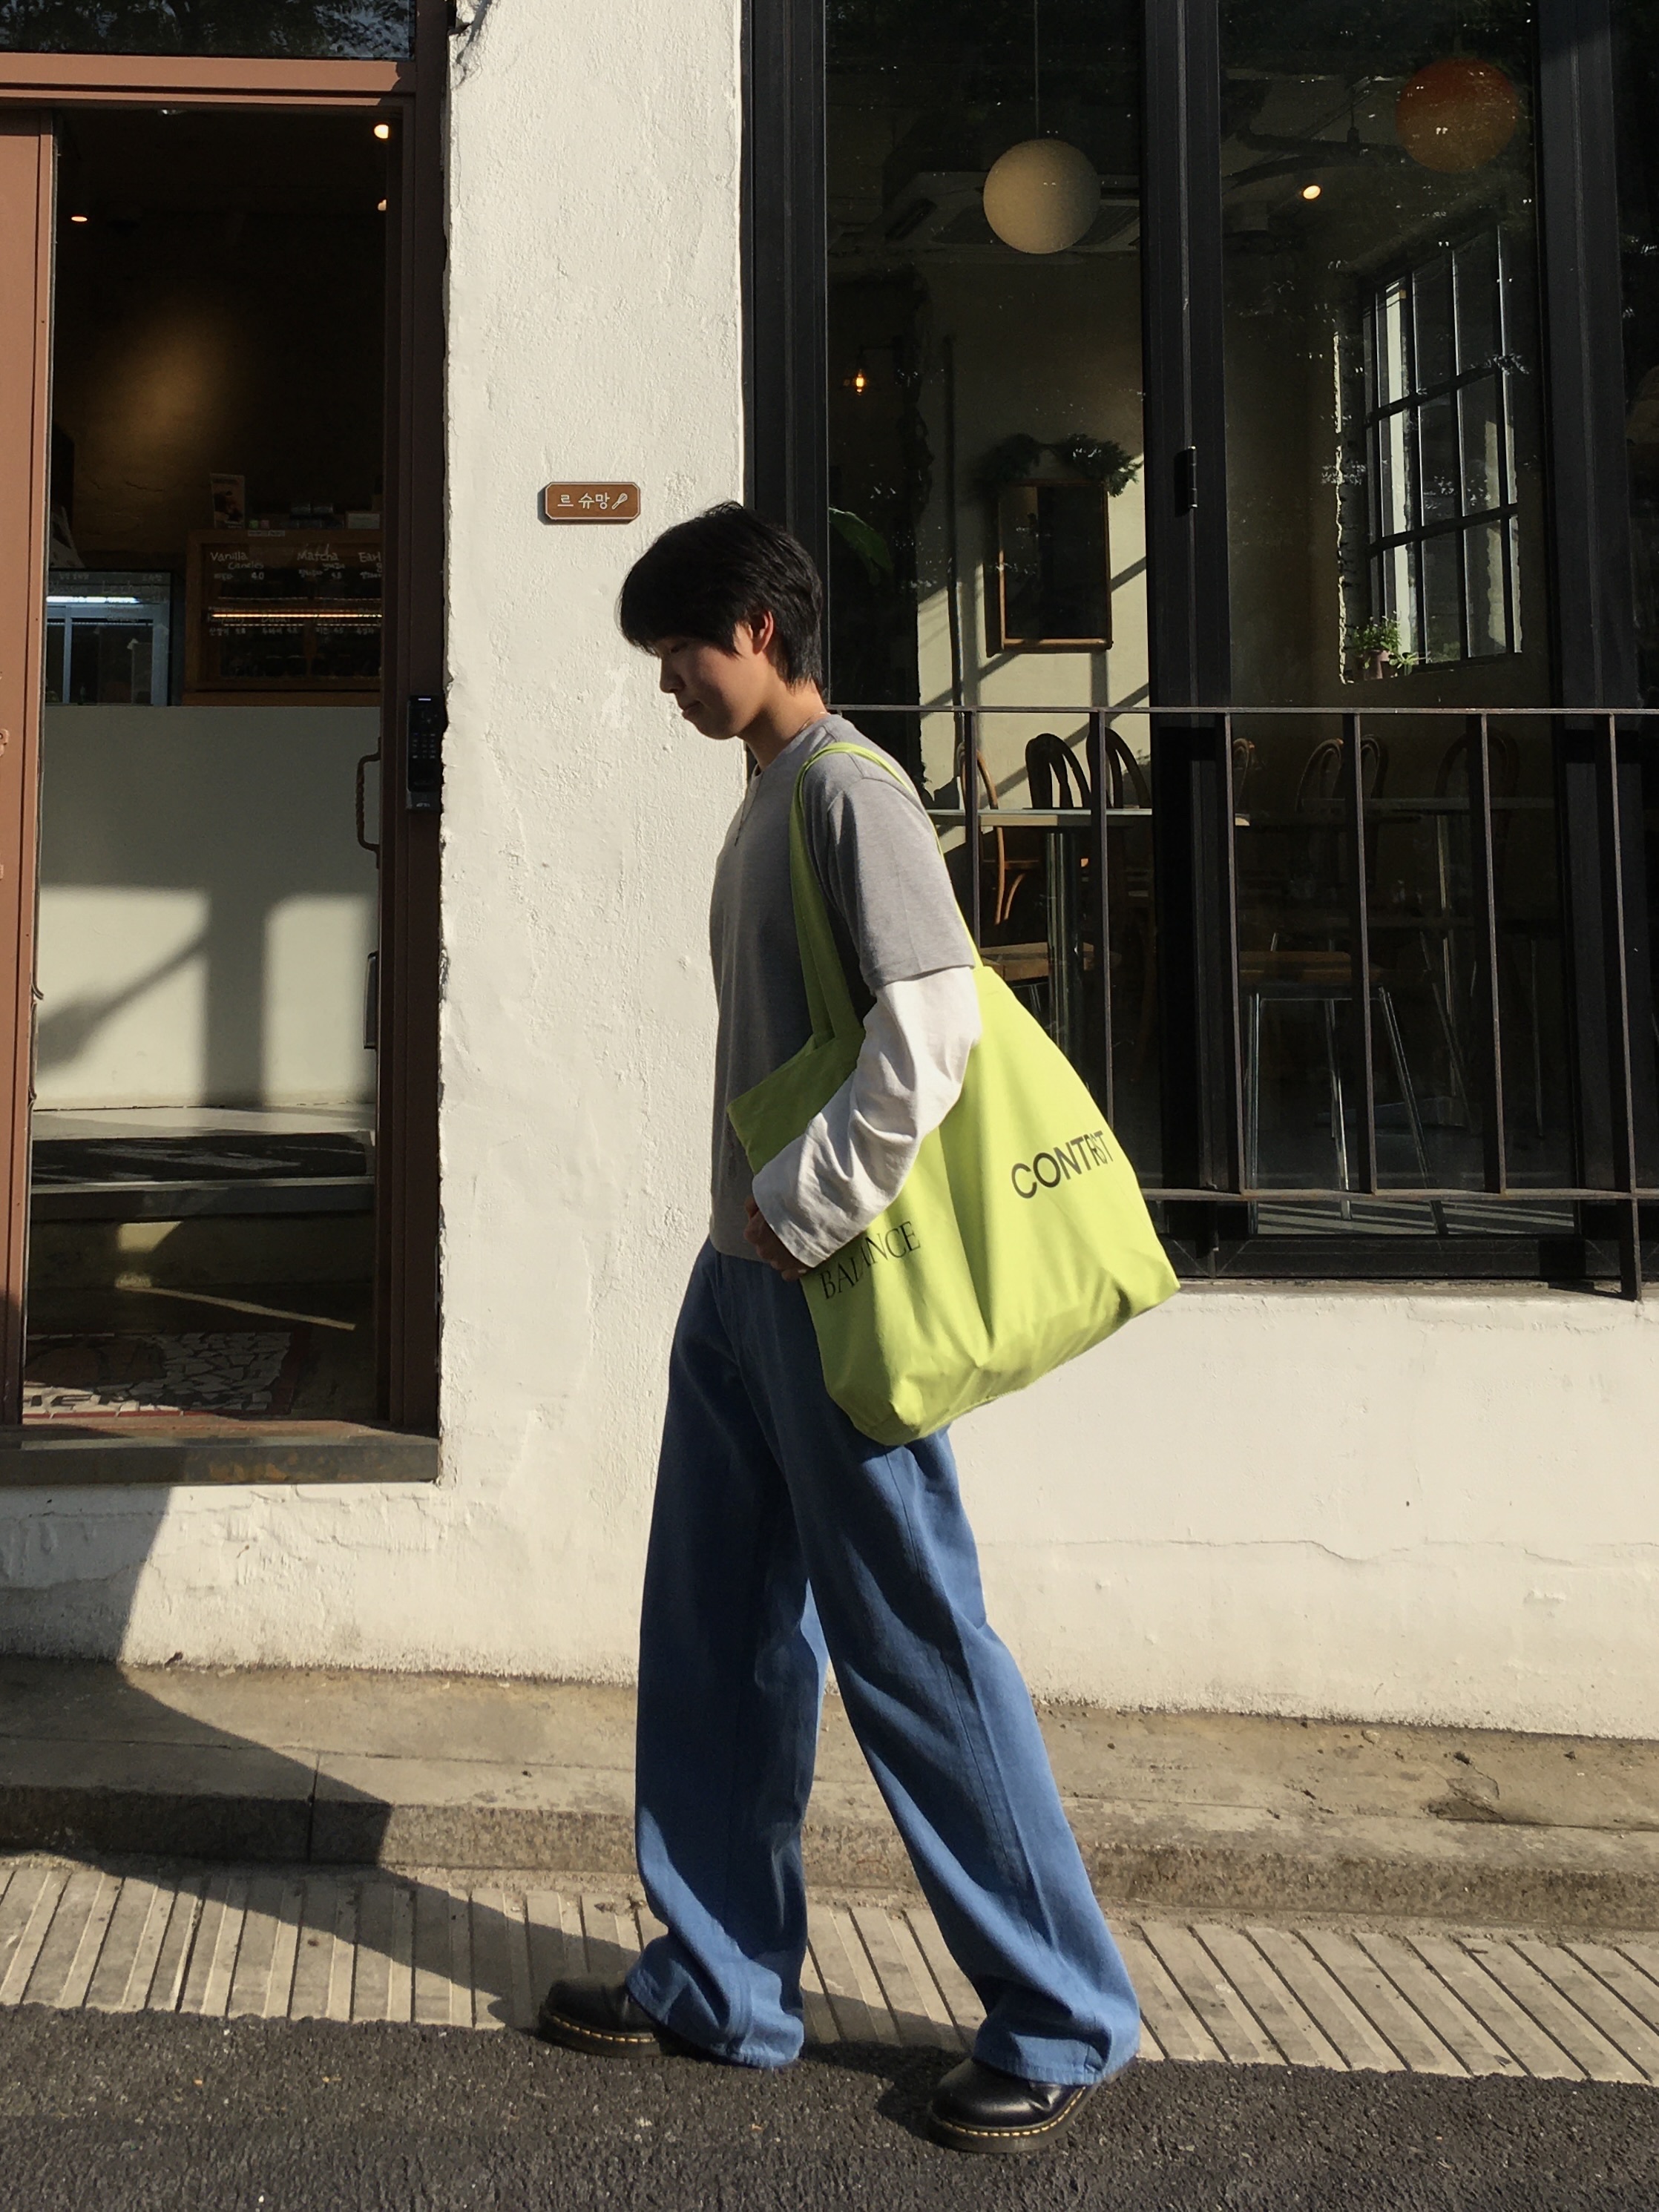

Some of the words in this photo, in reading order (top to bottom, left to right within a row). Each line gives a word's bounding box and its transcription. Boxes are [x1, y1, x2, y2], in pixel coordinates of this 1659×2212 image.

[557, 495, 574, 506] 르
[578, 493, 610, 509] 슈망
[210, 551, 248, 562] Vanilla
[297, 544, 339, 562] Matcha
